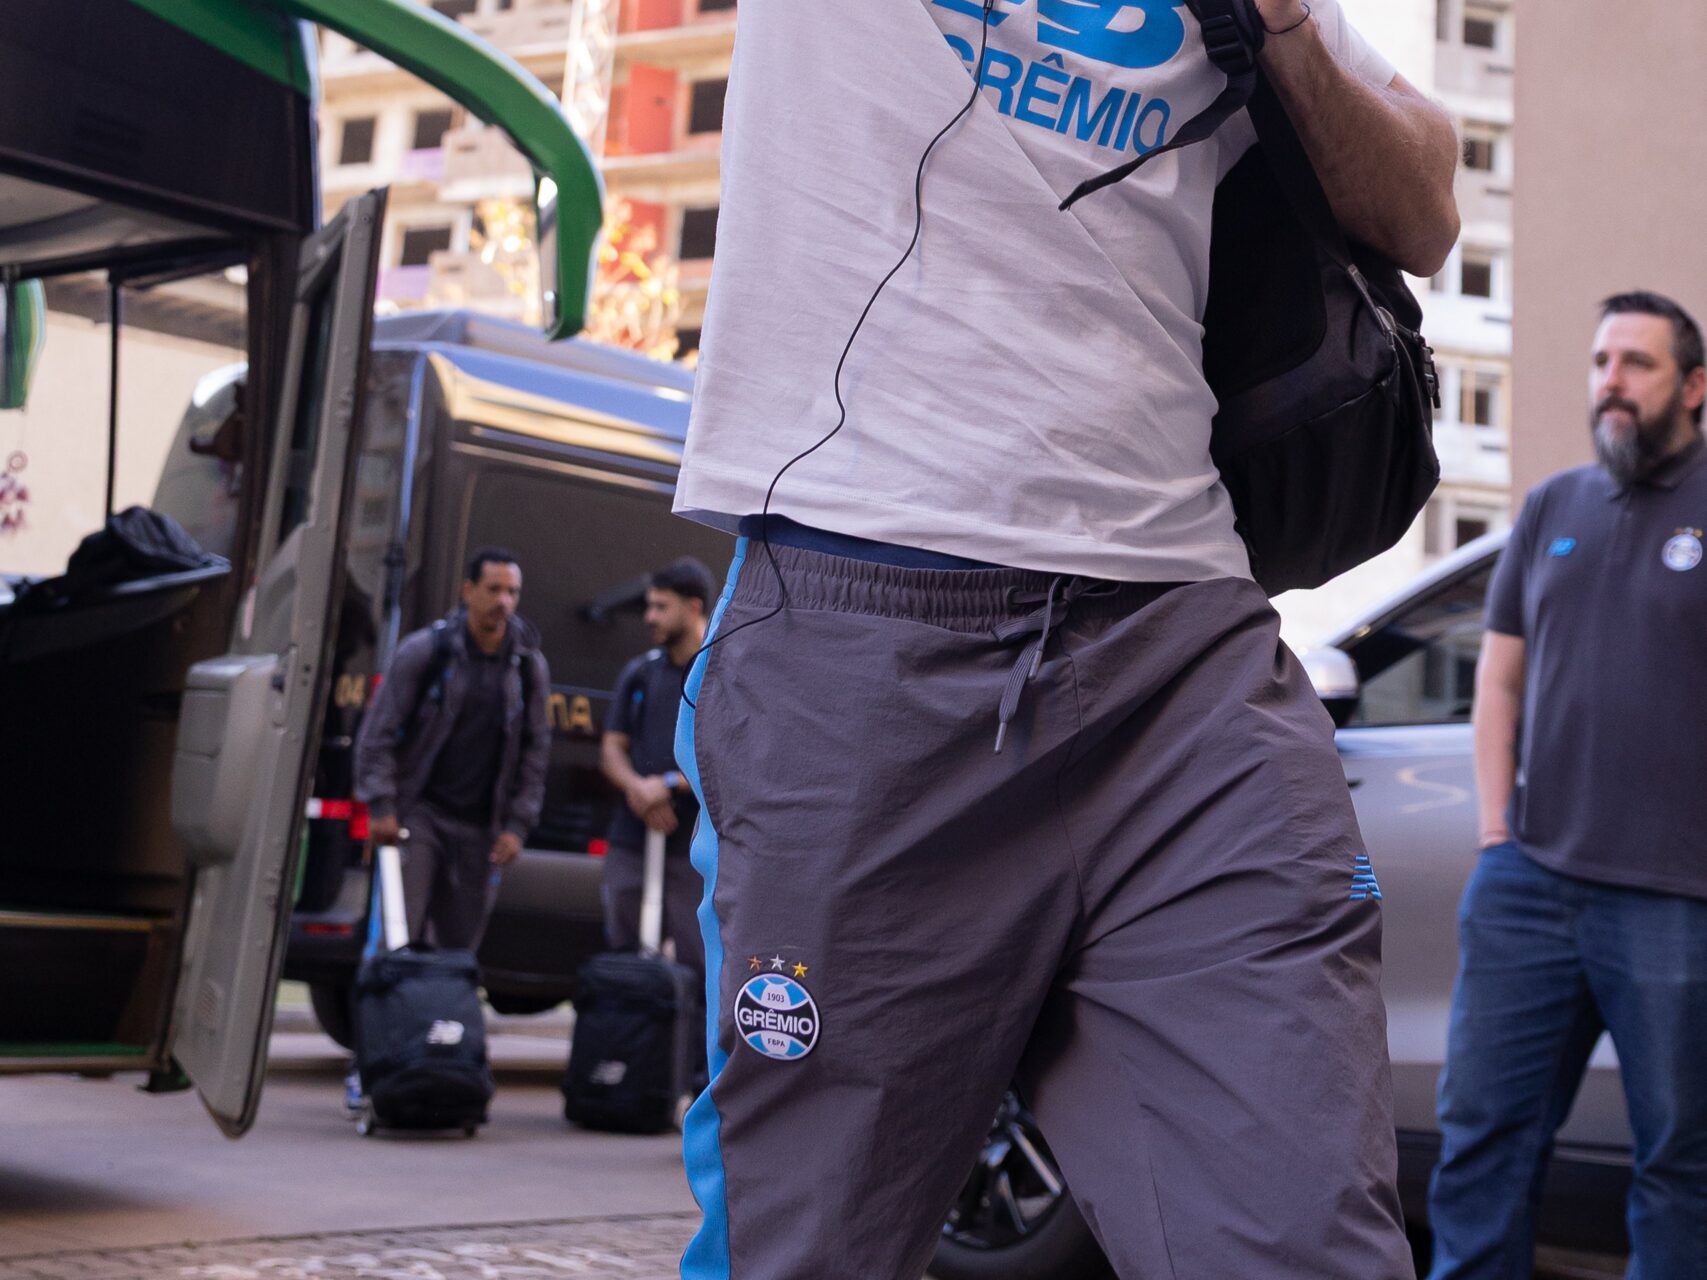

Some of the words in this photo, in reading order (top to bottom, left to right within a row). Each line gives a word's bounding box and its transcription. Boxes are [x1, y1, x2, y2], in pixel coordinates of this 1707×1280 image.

[767, 992, 785, 1003] 1903
[739, 1008, 814, 1035] GRÊMIO
[767, 1037, 786, 1048] FBPA
